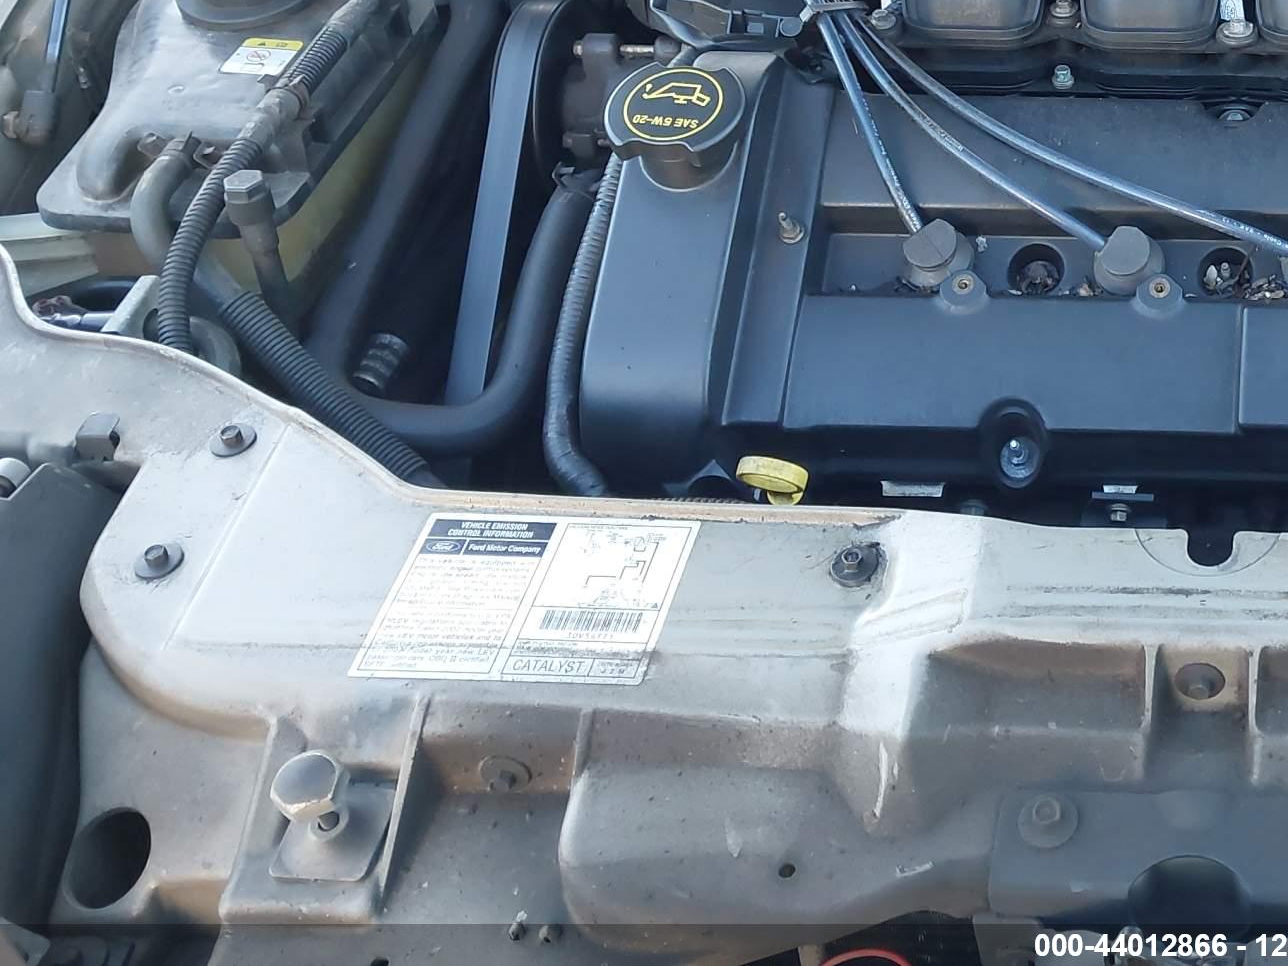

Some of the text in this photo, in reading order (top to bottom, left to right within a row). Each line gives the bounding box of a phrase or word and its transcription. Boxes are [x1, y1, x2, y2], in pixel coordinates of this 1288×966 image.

[632, 114, 699, 129] SAE 5W-20
[461, 521, 529, 531] VEHICLE EMISSION
[447, 528, 535, 539] CONTROL INFORMATION
[468, 543, 542, 554] Ford Motor Company
[512, 658, 586, 674] CATALYST
